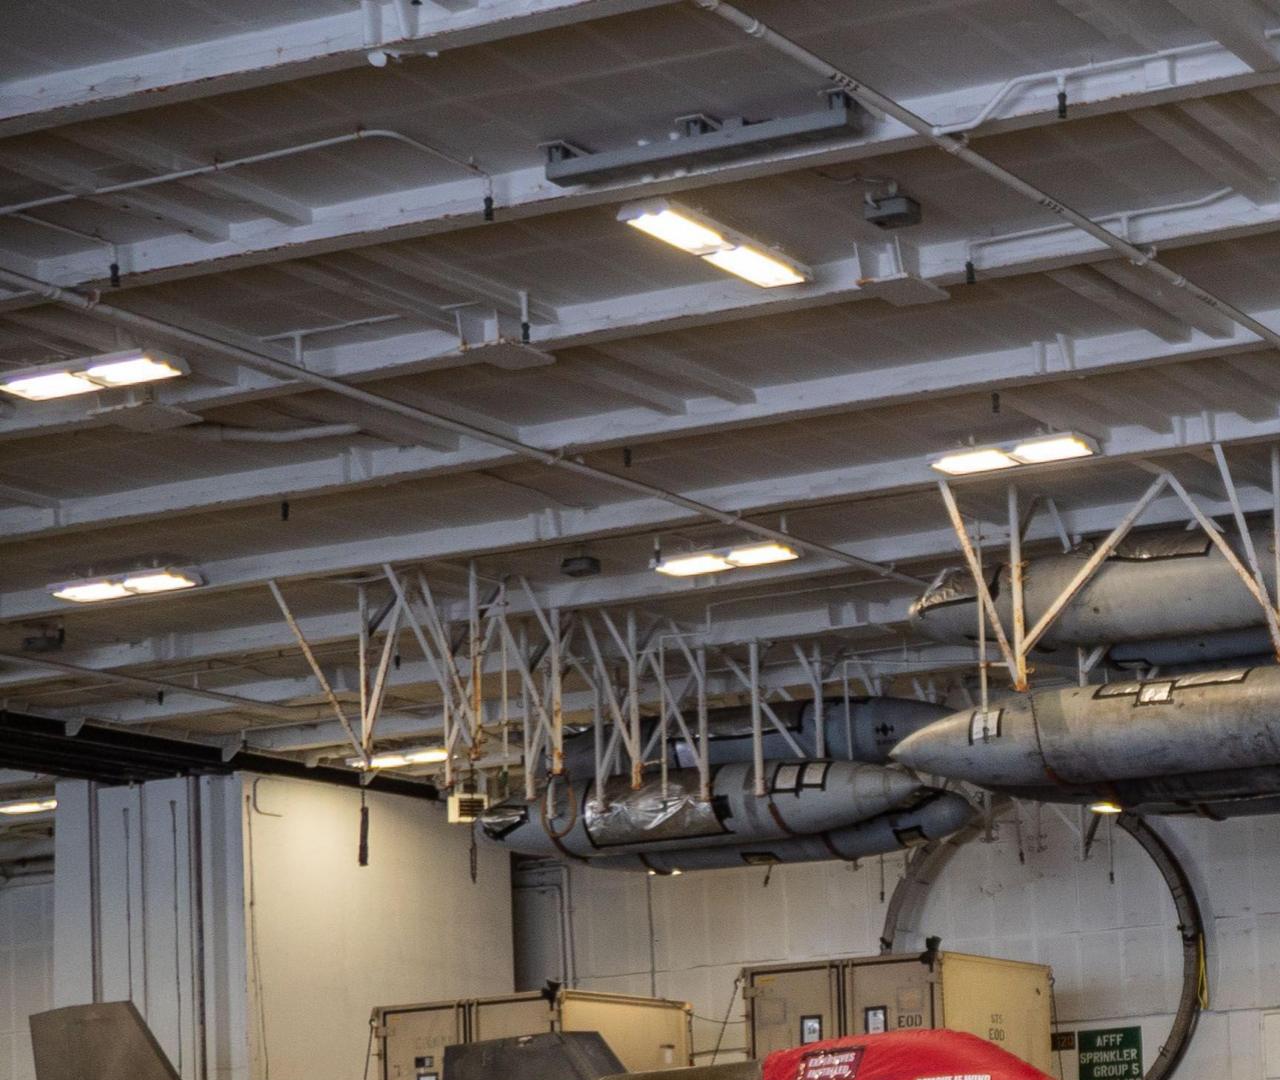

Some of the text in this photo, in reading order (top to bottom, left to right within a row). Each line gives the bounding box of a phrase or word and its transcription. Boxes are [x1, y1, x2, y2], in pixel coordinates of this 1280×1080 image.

[898, 1015, 922, 1027] EOD
[988, 1028, 1006, 1041] EOD
[1096, 1034, 1125, 1047] AFFF
[1080, 1050, 1138, 1064] SPRINKLER
[1093, 1065, 1132, 1077] GROUP
